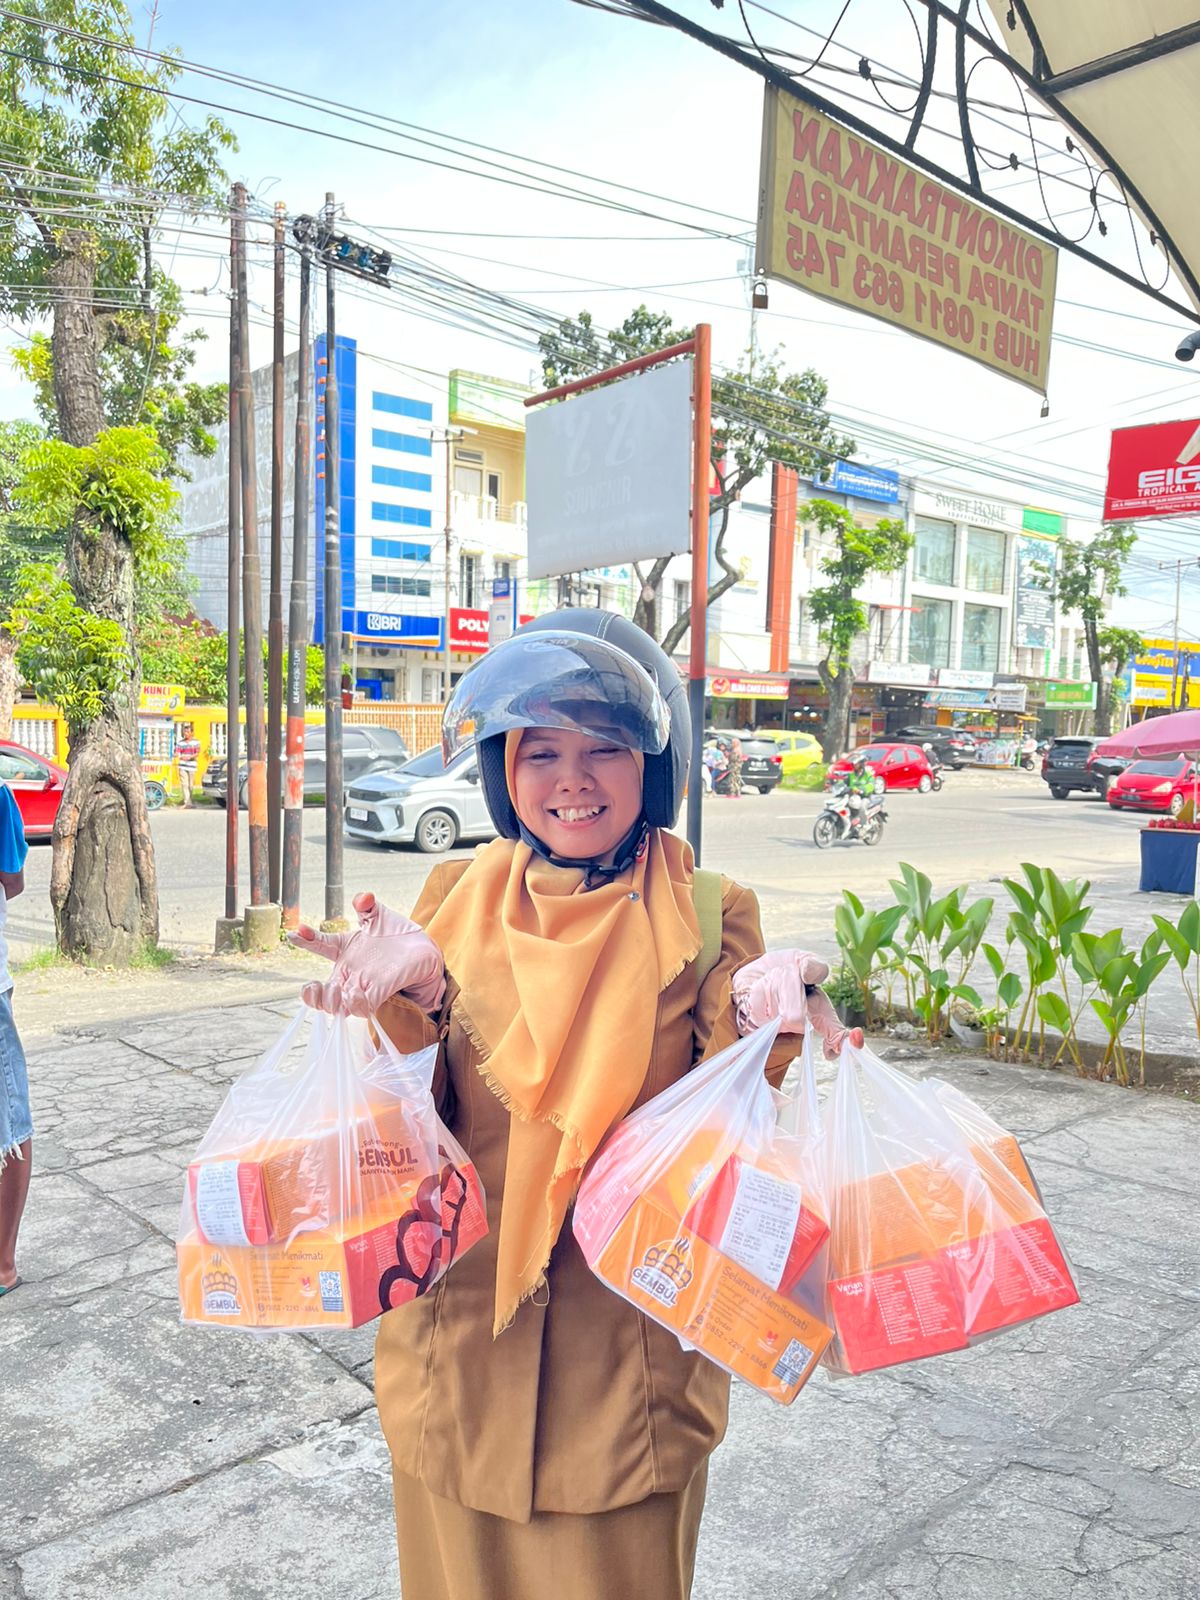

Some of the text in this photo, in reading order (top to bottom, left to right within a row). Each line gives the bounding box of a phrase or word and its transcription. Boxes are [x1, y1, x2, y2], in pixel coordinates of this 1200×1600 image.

[1138, 483, 1188, 497] TROPICAL
[936, 492, 972, 513] SWEET
[974, 500, 1007, 521] HOME
[381, 615, 401, 631] BRI
[144, 686, 170, 695] KUNCI
[632, 1268, 679, 1303] GEMBUL
[722, 1266, 760, 1298] Selamat
[760, 1292, 809, 1330] Menikmati
